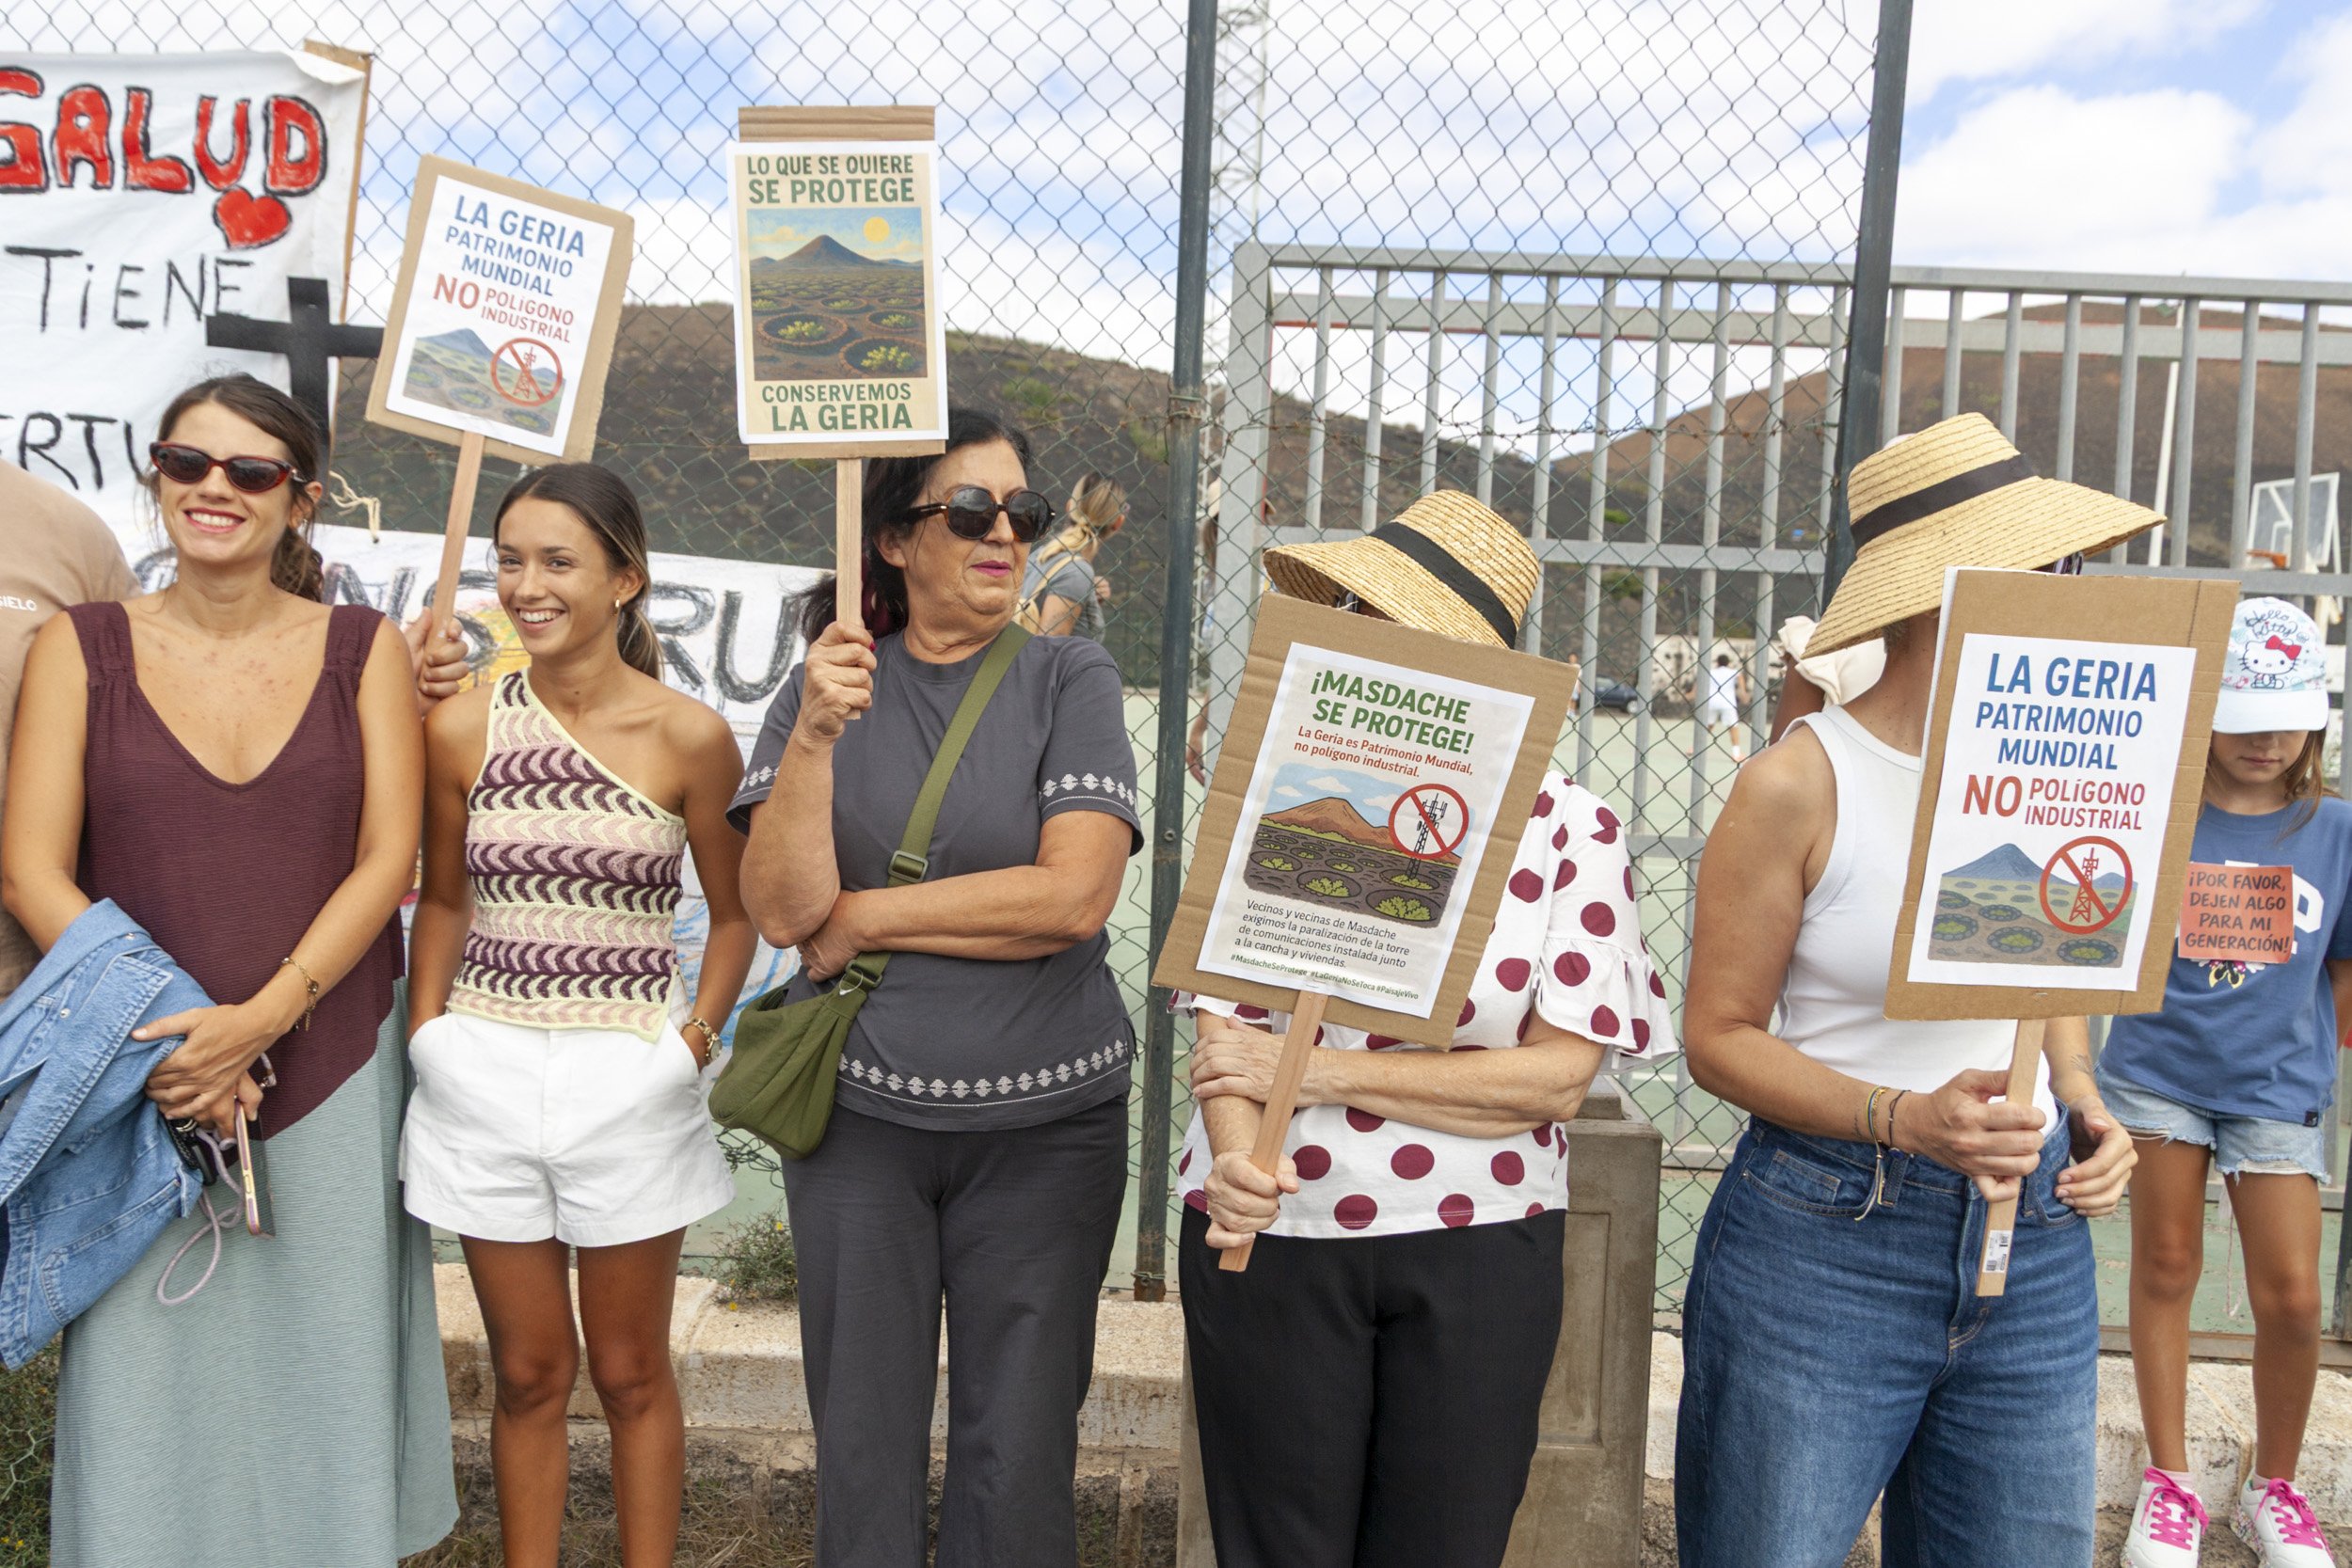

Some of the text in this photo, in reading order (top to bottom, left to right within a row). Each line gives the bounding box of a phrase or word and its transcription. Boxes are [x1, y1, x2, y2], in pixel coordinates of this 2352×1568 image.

[0, 66, 327, 197] SALUD
[747, 154, 914, 176] LO QUE SE QUIERE
[748, 177, 914, 204] SE PROTEGE
[453, 195, 584, 258] LA GERIA
[445, 226, 573, 278] PATRIMONIO
[433, 273, 480, 310] NO
[461, 255, 554, 297] MUNDIAL
[481, 306, 572, 344] INDUSTRIAL
[761, 383, 912, 404] CONSERVEMOS
[771, 403, 914, 433] LA GERIA
[2245, 610, 2290, 627] Hello
[1986, 653, 2157, 703] LA GERIA
[1311, 670, 1471, 724] ¡MASDACHE
[1312, 699, 1474, 755] SE PROTEGE!
[1975, 701, 2143, 738] PATRIMONIO
[1294, 741, 1420, 778] no polígono industrial.
[1298, 725, 1473, 776] La Geria es Patrimonio Mundial,
[1997, 737, 2118, 770] MUNDIAL
[1963, 774, 2023, 817] NO
[2024, 804, 2143, 831] INDUSTRIAL
[2188, 871, 2286, 892] ¡POR FAVOR,
[1247, 899, 1396, 940] Vecinos y vecinas de Masdache
[2190, 892, 2286, 911] DEJEN ALGO
[1243, 912, 1410, 956] exigimos la paralización de la torre
[2199, 912, 2271, 931] PARA MI
[1234, 938, 1346, 969] a la cancha y viviendas.
[1238, 924, 1406, 968] de comunicaciones instalada junto
[2185, 932, 2290, 954] GENERACIÓN!
[1231, 954, 1419, 1000] #MasdacheSeProtege #LaGeriaNoSeToca #PaisajeVivo
